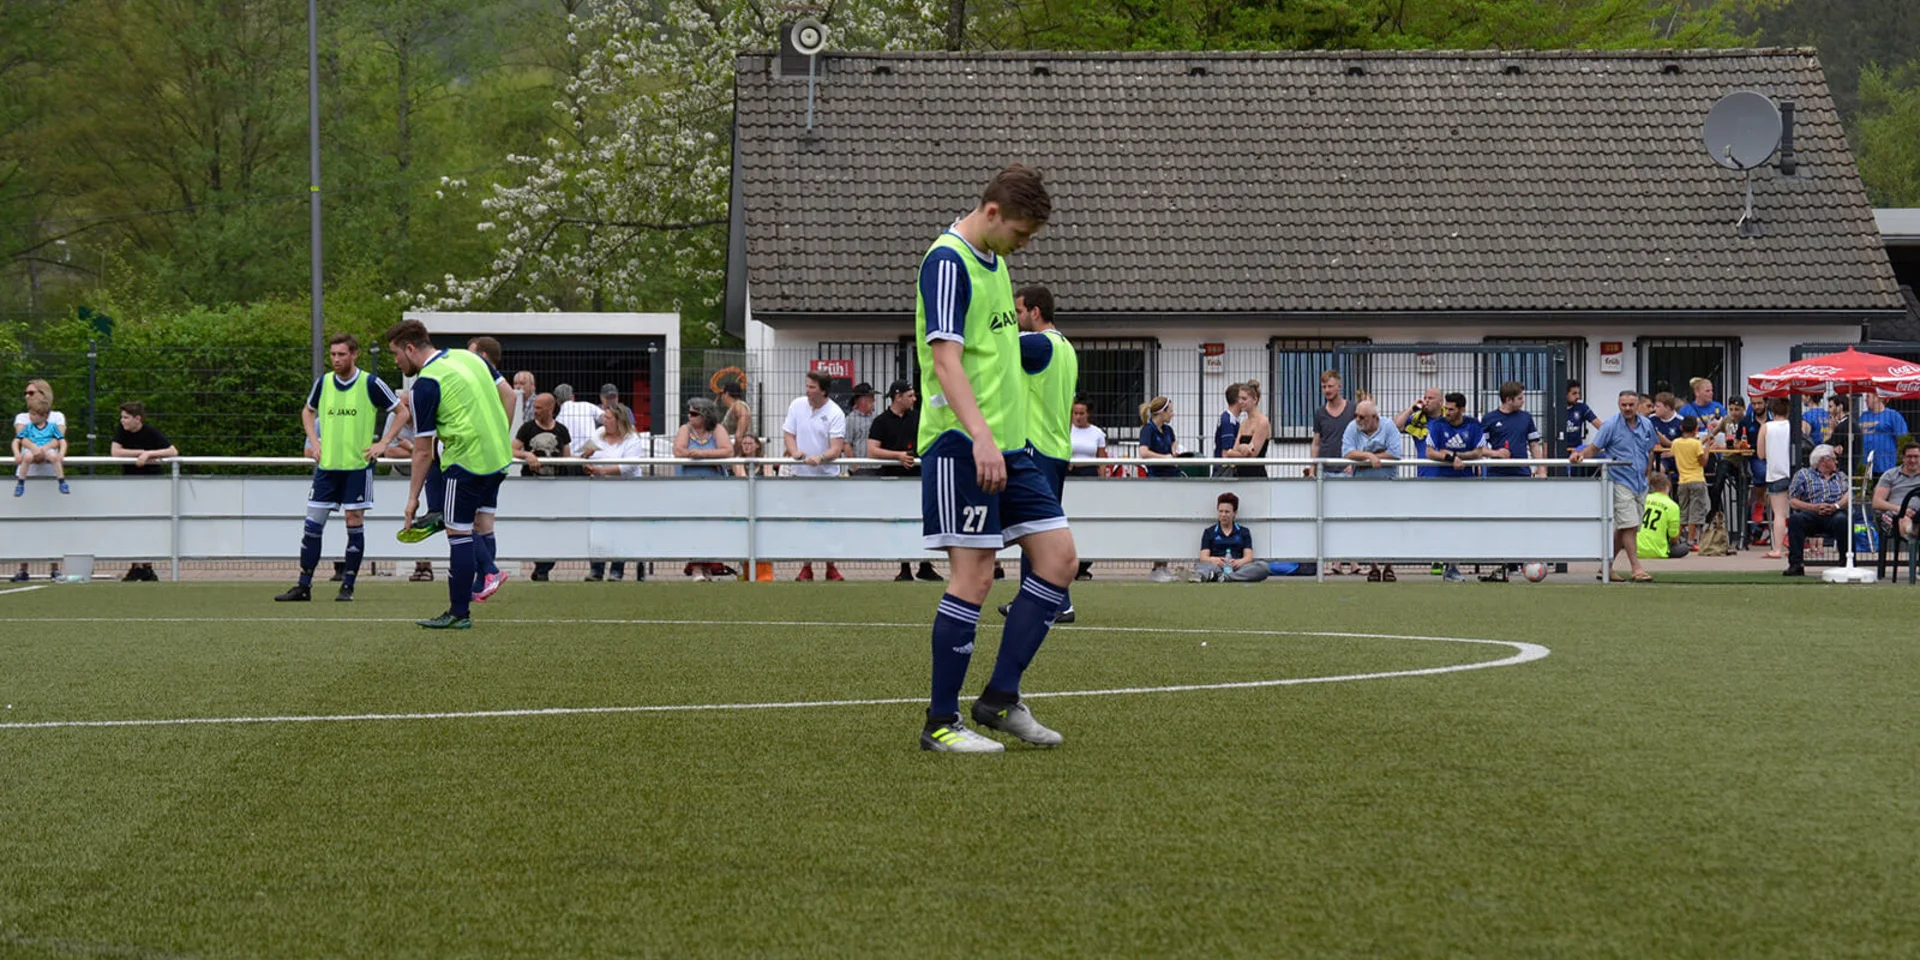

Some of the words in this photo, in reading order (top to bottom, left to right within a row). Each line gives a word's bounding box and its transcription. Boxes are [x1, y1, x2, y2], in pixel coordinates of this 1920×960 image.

[336, 408, 357, 416] JAKO
[962, 505, 988, 532] 27
[1642, 508, 1662, 531] 42
